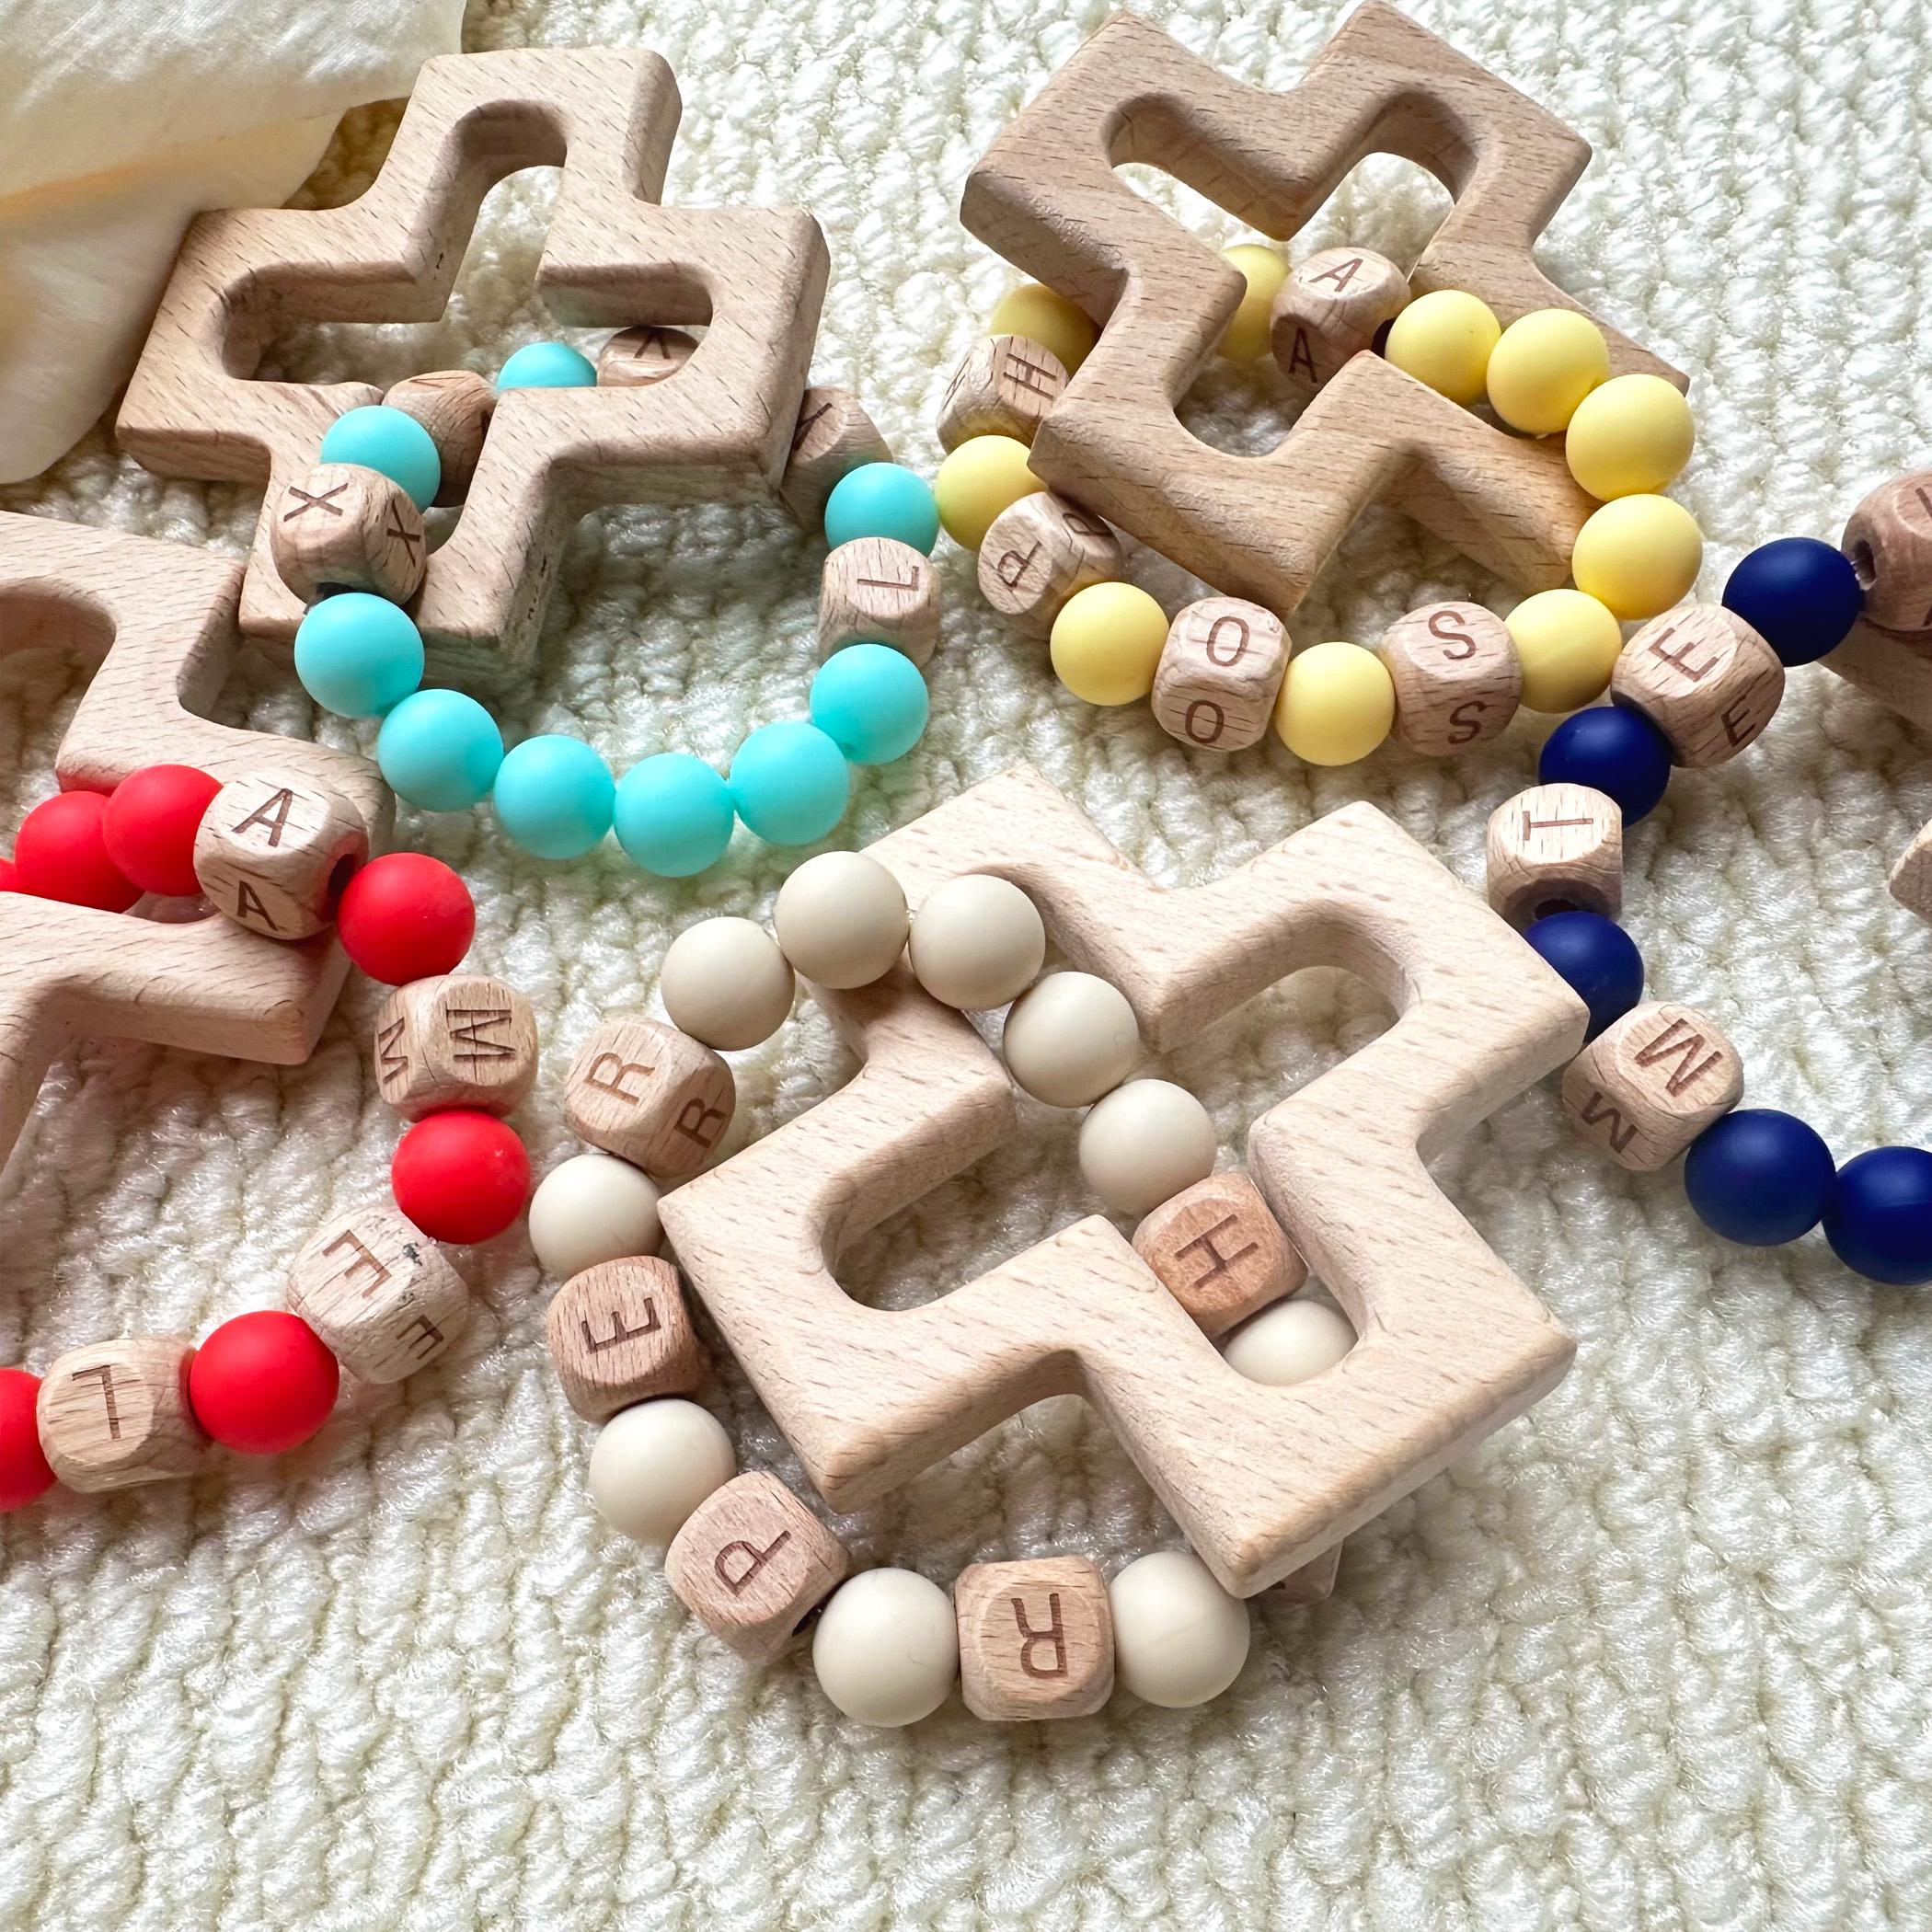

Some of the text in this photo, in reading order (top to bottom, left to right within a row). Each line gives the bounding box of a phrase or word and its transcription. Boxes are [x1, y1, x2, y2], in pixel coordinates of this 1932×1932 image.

[1308, 259, 1363, 292] A
[1005, 353, 1057, 399] H
[1289, 327, 1317, 384] A
[283, 482, 349, 522] X
[386, 499, 420, 567] X
[857, 566, 918, 592] L
[997, 540, 1042, 588] P
[1206, 616, 1249, 667] O
[1428, 610, 1477, 660] S
[1648, 627, 1719, 682] E
[1185, 699, 1225, 744] O
[1448, 700, 1485, 744] S
[1720, 695, 1755, 747] E
[232, 788, 293, 846] A
[1523, 811, 1593, 841] T
[236, 880, 279, 930] A
[445, 1009, 516, 1063] M
[1635, 1018, 1723, 1098] M
[583, 1052, 655, 1104] R
[673, 1097, 726, 1148] R
[1581, 1091, 1640, 1153] M
[322, 1229, 393, 1300] E
[1174, 1214, 1259, 1289] H
[396, 1314, 444, 1360] E
[581, 1297, 661, 1354] E
[72, 1364, 121, 1440] L
[713, 1530, 791, 1597] P
[1010, 1593, 1069, 1679] R
